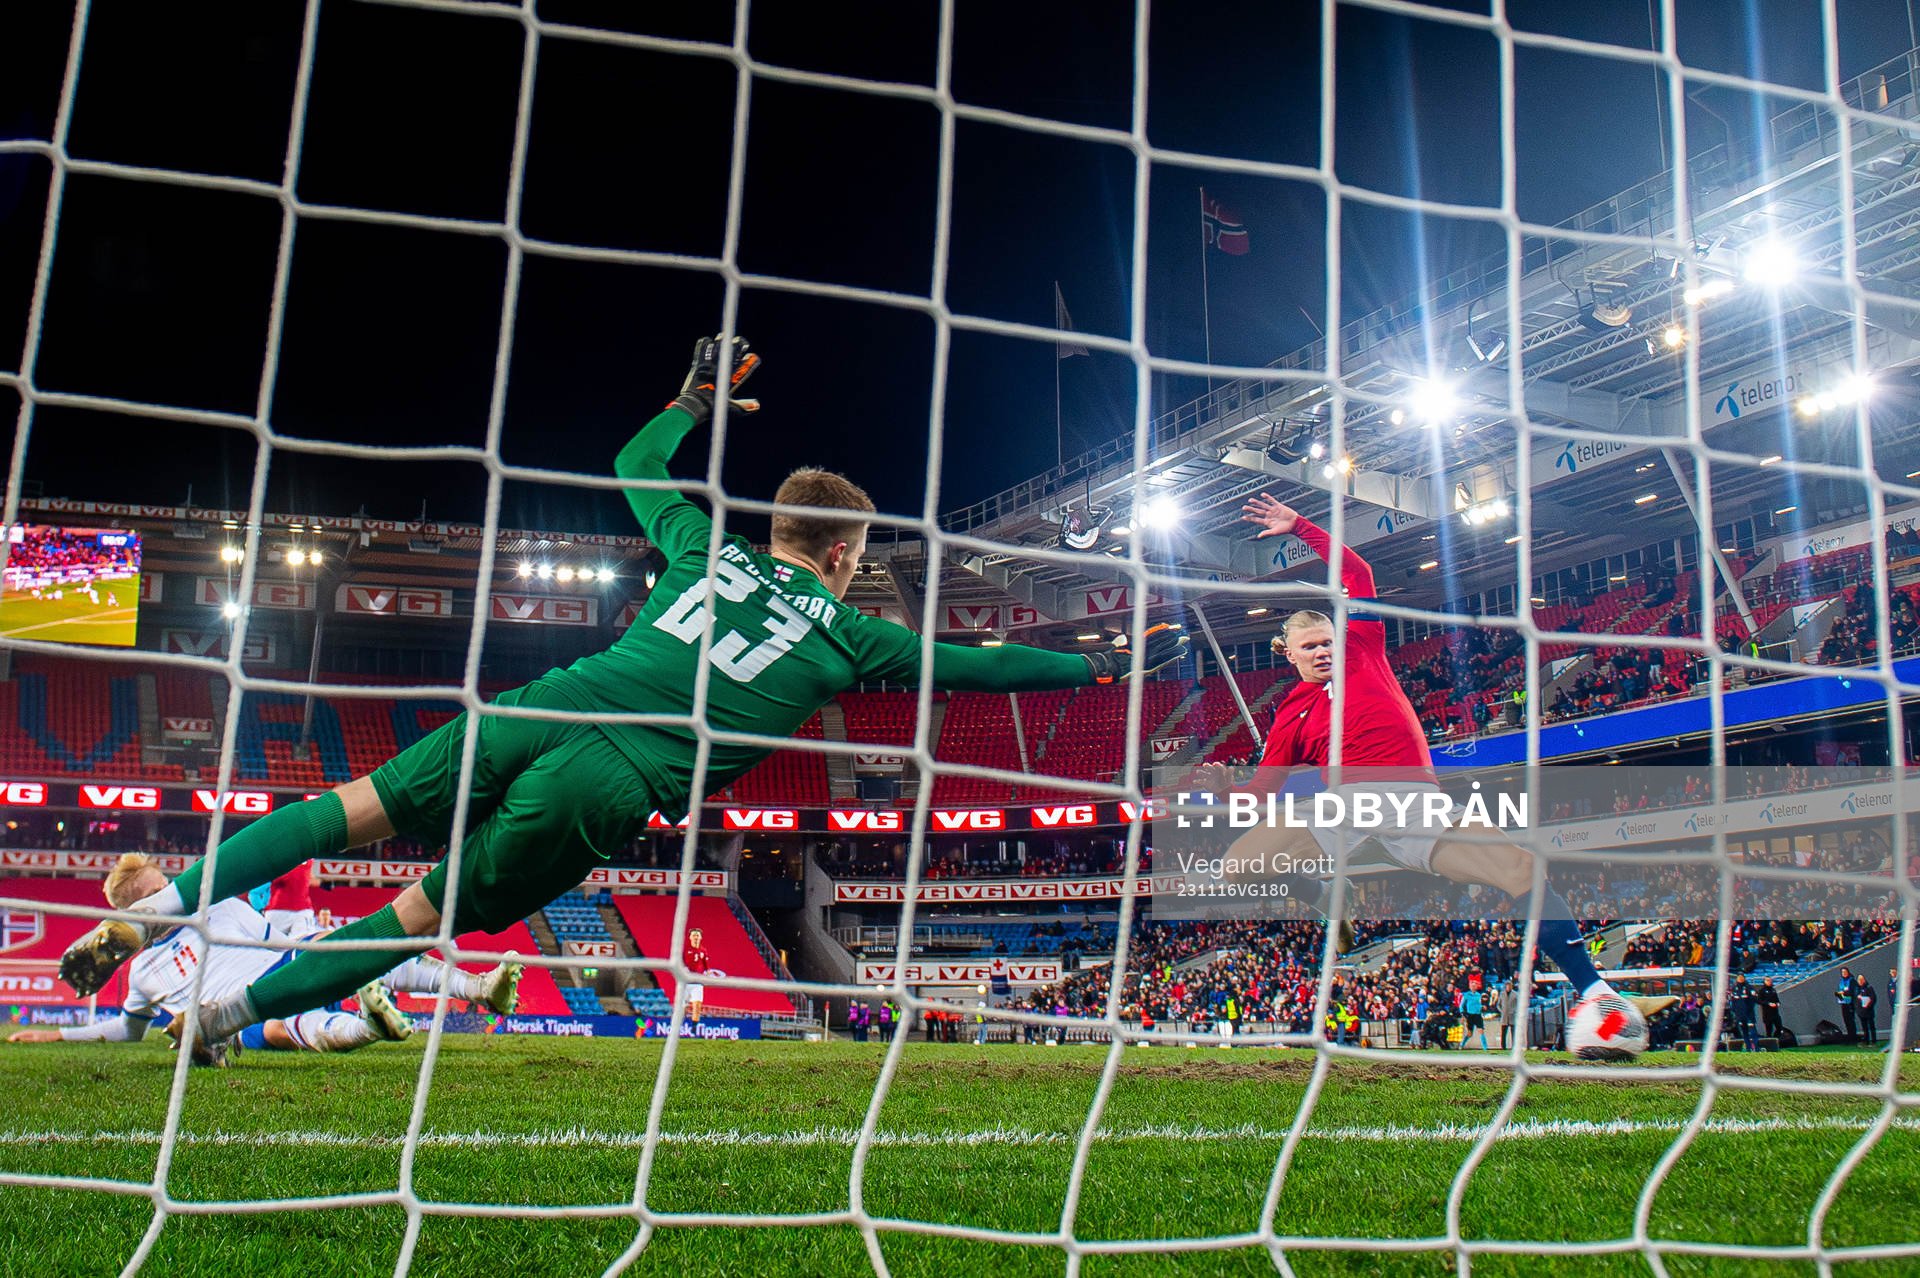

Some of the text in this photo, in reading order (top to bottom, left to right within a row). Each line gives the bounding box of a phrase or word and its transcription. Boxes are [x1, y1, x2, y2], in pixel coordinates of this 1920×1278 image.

[1741, 373, 1800, 407] teleno
[350, 586, 437, 614] VG
[494, 596, 584, 623] VG
[652, 560, 813, 682] 23
[166, 719, 212, 732] VG
[857, 753, 904, 765] VG
[84, 787, 157, 807] VG
[197, 791, 268, 811] VG
[1855, 792, 1894, 809] telenor
[1033, 805, 1093, 825] VG
[1772, 803, 1808, 819] telenor
[726, 811, 794, 828] VG
[831, 812, 898, 829] VG
[934, 811, 1000, 829] VG
[1561, 829, 1590, 843] telenor
[1626, 821, 1657, 836] telenor
[3, 852, 54, 865] VG
[322, 862, 368, 876] VG
[383, 863, 431, 877] VG
[619, 871, 665, 883] VG
[839, 886, 890, 899] VG
[955, 886, 1004, 898] VG
[1011, 884, 1056, 897] VG
[1063, 883, 1104, 896] VG
[569, 942, 616, 956] VG
[940, 966, 991, 980] VG
[1009, 966, 1056, 980] VG
[507, 1018, 593, 1037] Norsk Tipping
[656, 1021, 695, 1037] Nosk
